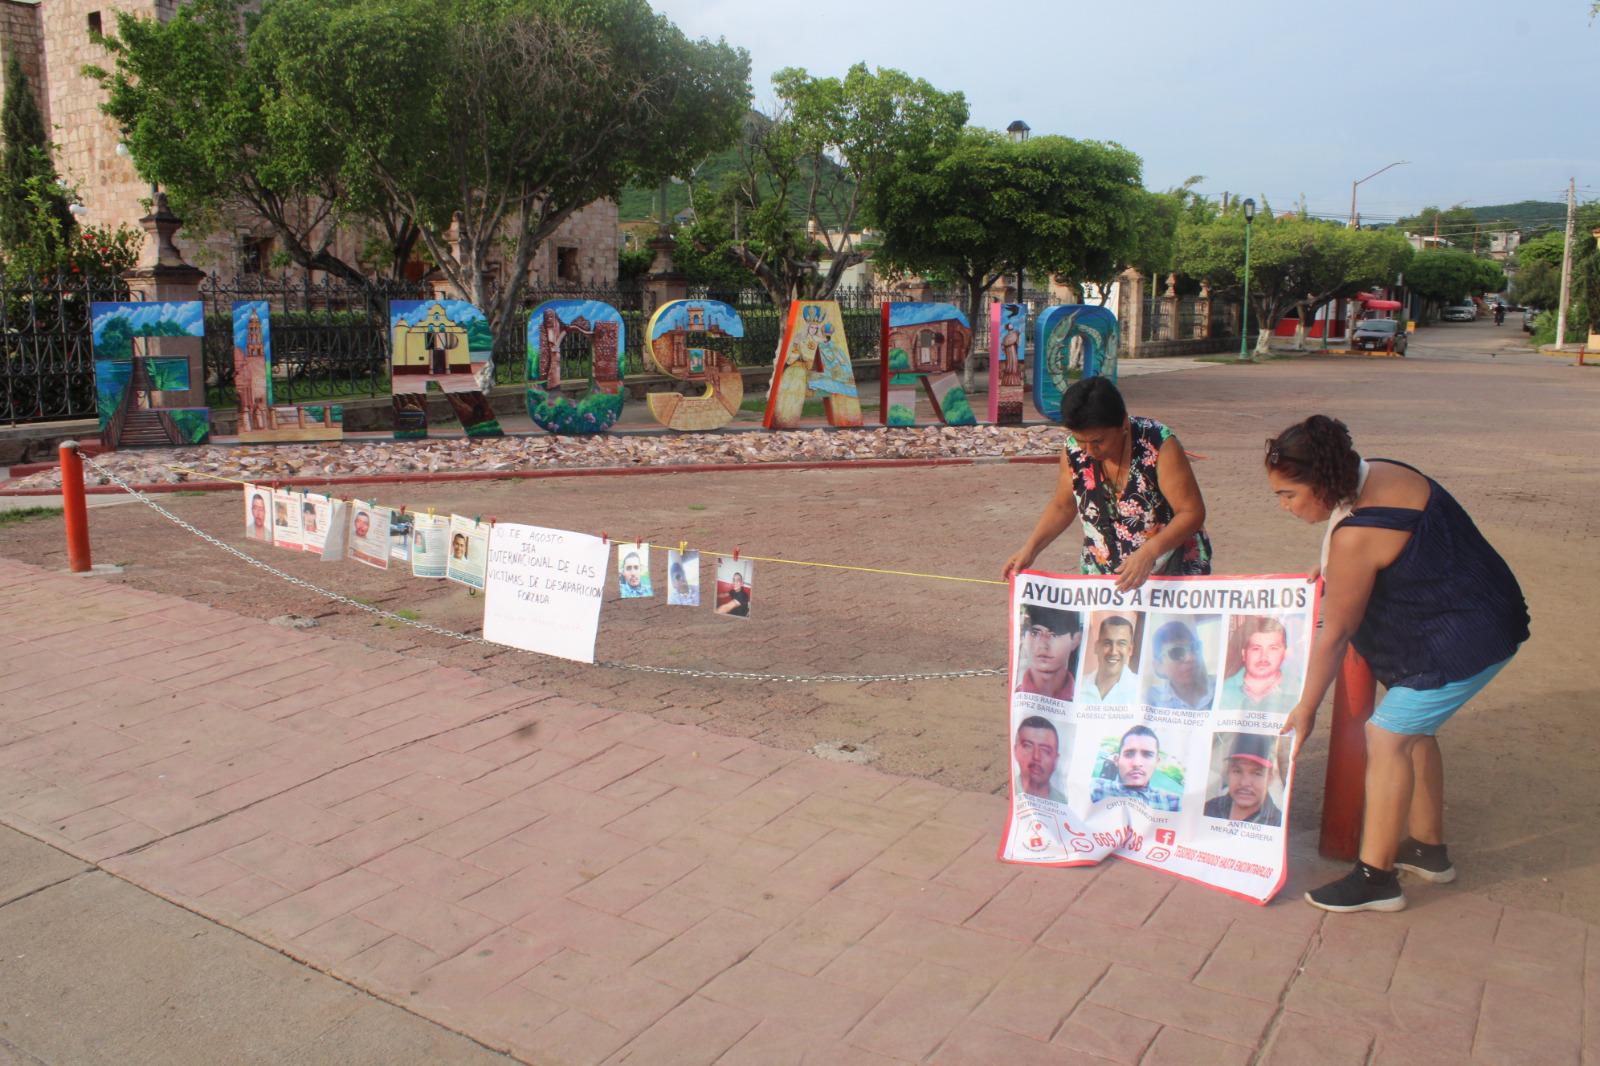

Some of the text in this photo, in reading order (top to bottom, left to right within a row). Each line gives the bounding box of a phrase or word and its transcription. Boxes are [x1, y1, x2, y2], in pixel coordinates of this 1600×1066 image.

[390, 298, 1119, 439] ROSARIO
[530, 531, 564, 543] AGOSTO
[488, 549, 553, 569] INTERNACIONAL
[558, 560, 570, 573] DE
[576, 564, 596, 579] LAS
[488, 569, 524, 586] VICTIMAS
[545, 579, 603, 599] DESAPARICION
[517, 590, 550, 605] FORZADA
[1021, 582, 1307, 609] AYUDANOS A ENCONTRARLOS
[1171, 709, 1210, 719] HUMBERTO
[1246, 712, 1267, 720] JOSE
[1216, 718, 1262, 729] LABRADOR
[1210, 825, 1273, 842] MERAZ CABRERA
[1228, 820, 1262, 832] ANTONIO
